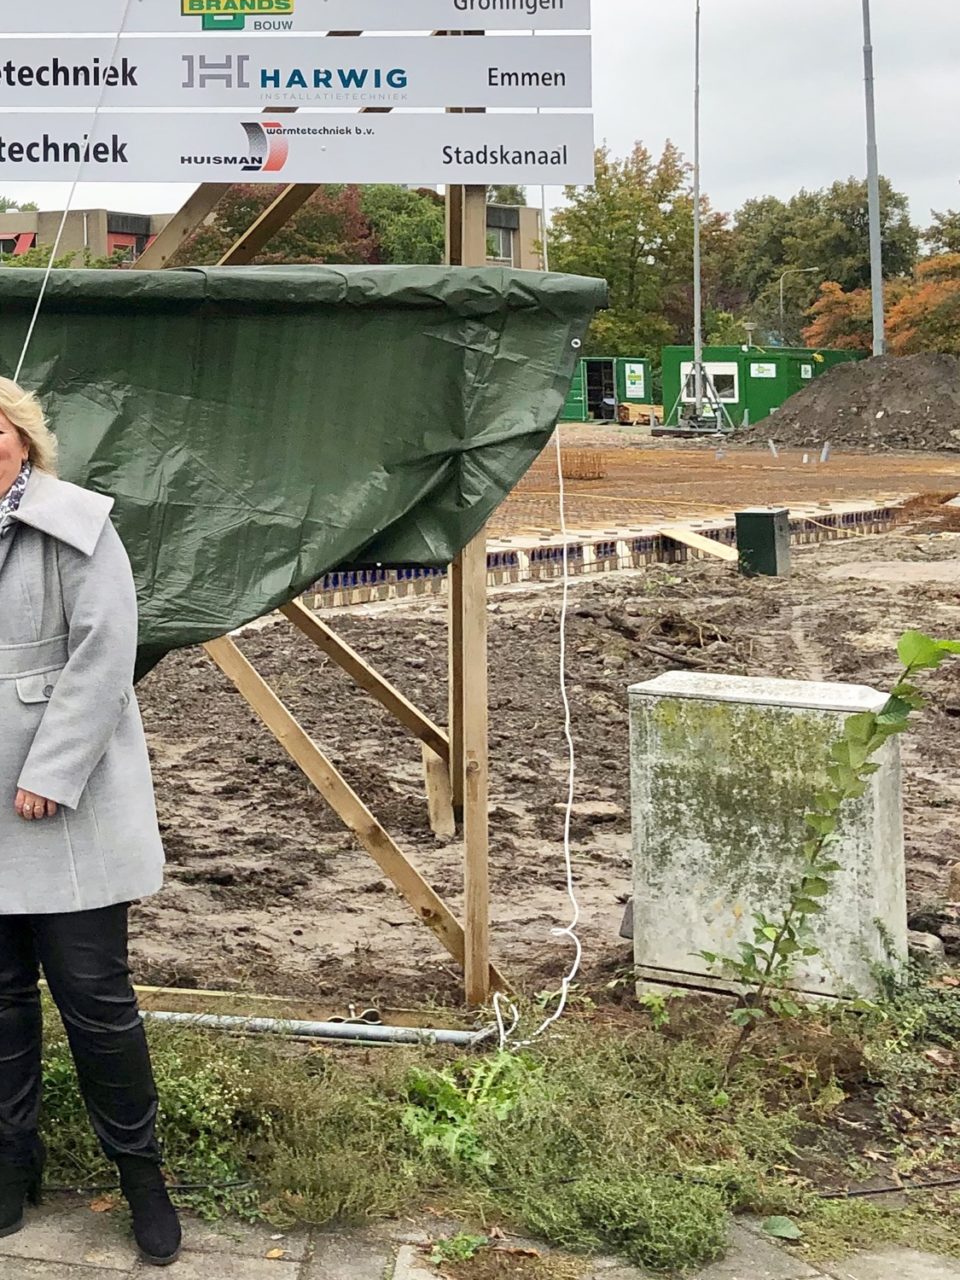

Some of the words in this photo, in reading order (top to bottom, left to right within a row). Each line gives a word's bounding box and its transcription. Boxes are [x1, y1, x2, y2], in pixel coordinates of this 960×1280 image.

[254, 21, 293, 30] BOUW
[260, 68, 408, 89] HARWIG
[488, 67, 566, 87] Emmen
[260, 93, 408, 101] INSTALLATIETECHNIEK
[266, 126, 352, 136] warmtetechniek
[442, 144, 568, 166] Stadskanaal
[180, 156, 263, 165] HUISMAN
